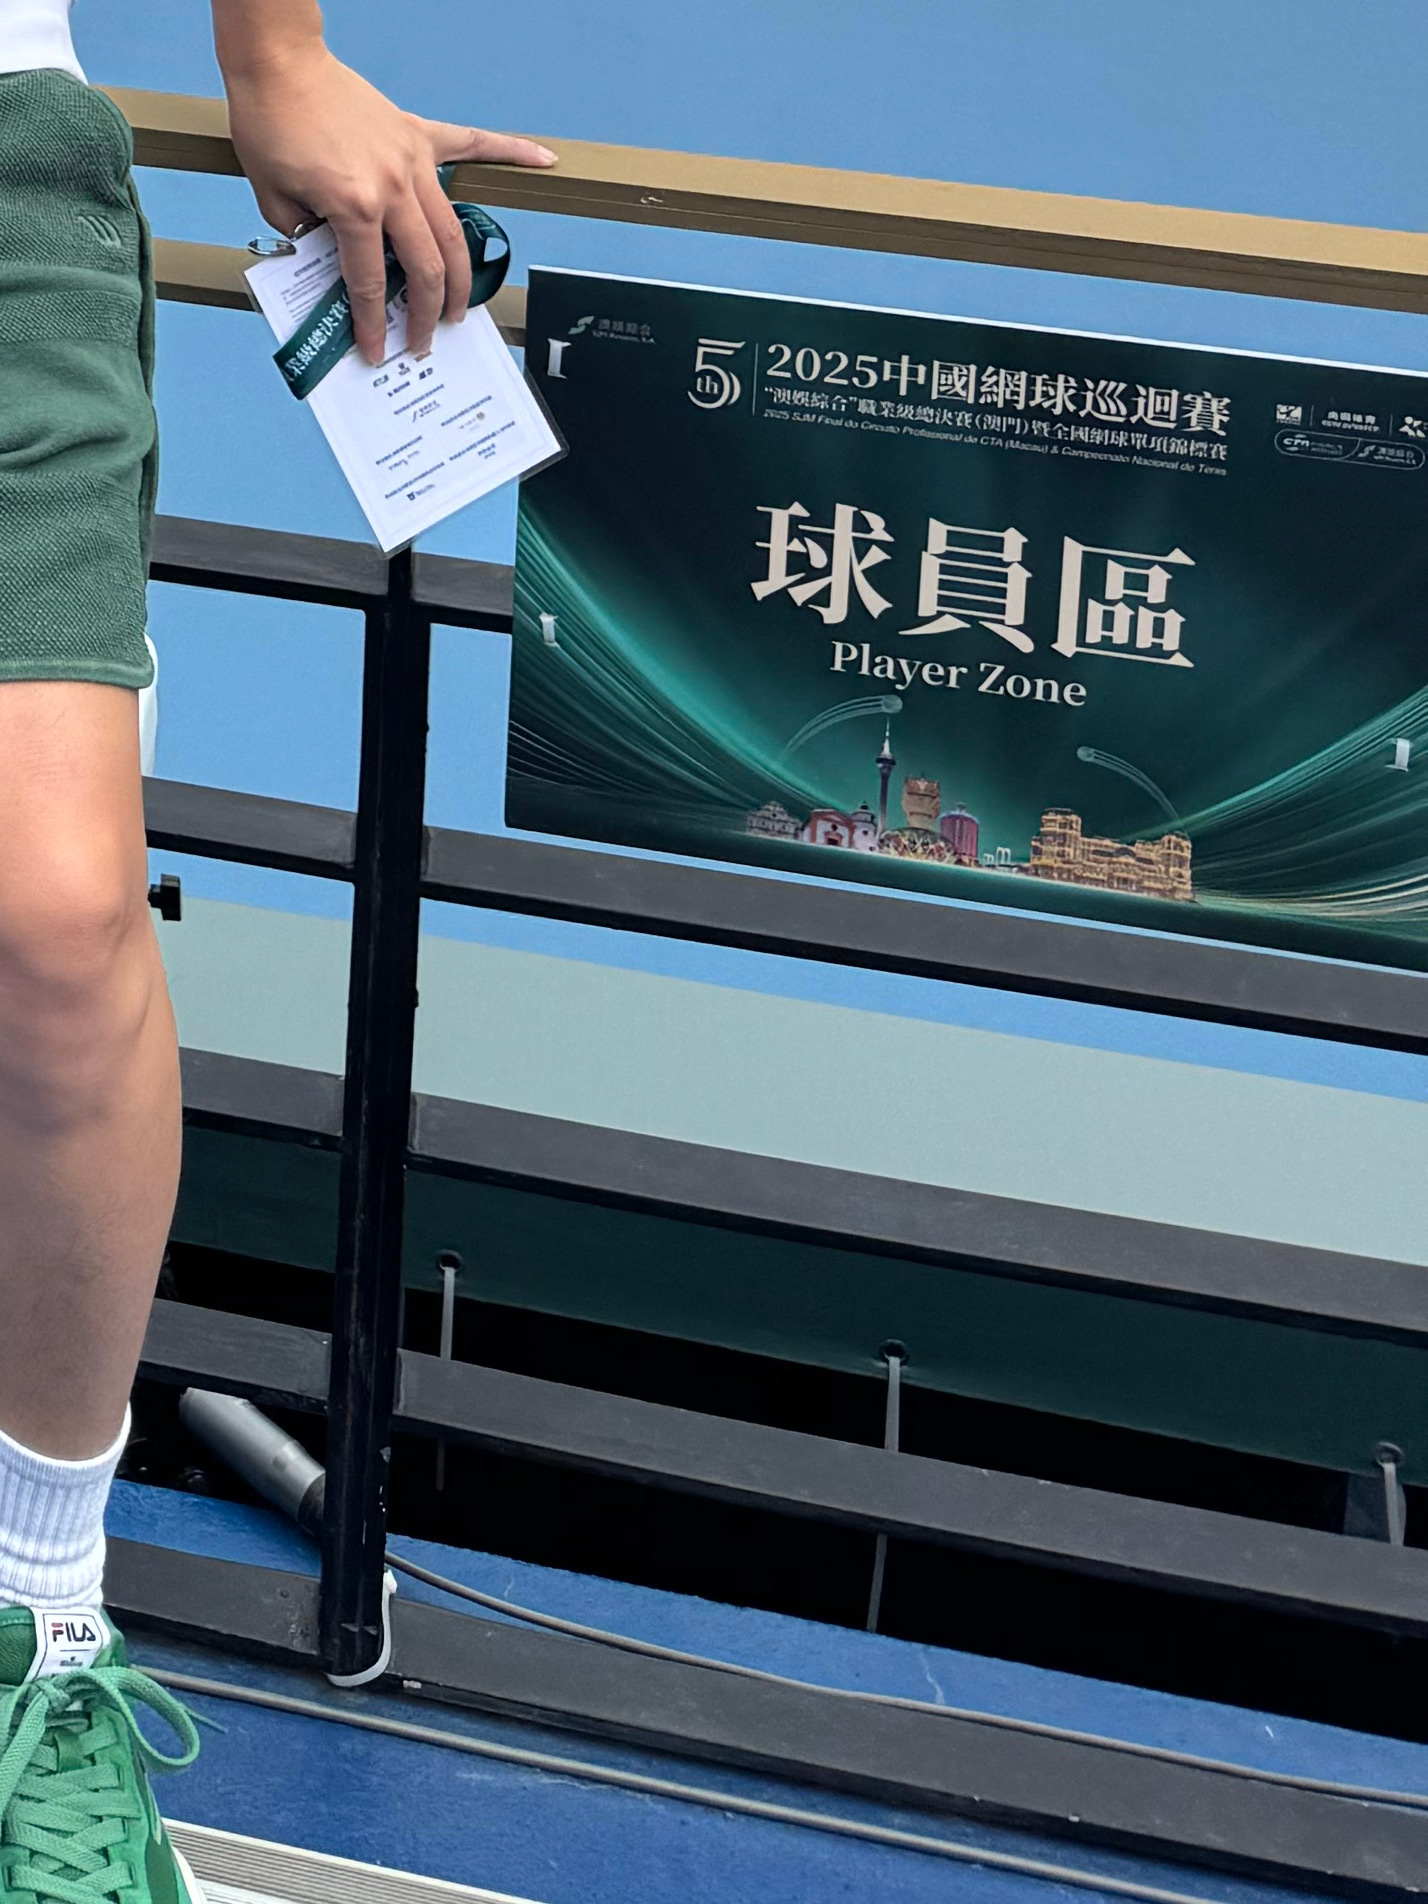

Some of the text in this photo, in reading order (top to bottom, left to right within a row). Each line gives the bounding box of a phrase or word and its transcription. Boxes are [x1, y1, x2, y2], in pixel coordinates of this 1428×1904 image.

[766, 343, 1232, 438] 2025中國網球巡迴賽
[750, 500, 1196, 668] 球員區
[830, 640, 1087, 707] Player Zone
[51, 1621, 96, 1643] FILA
